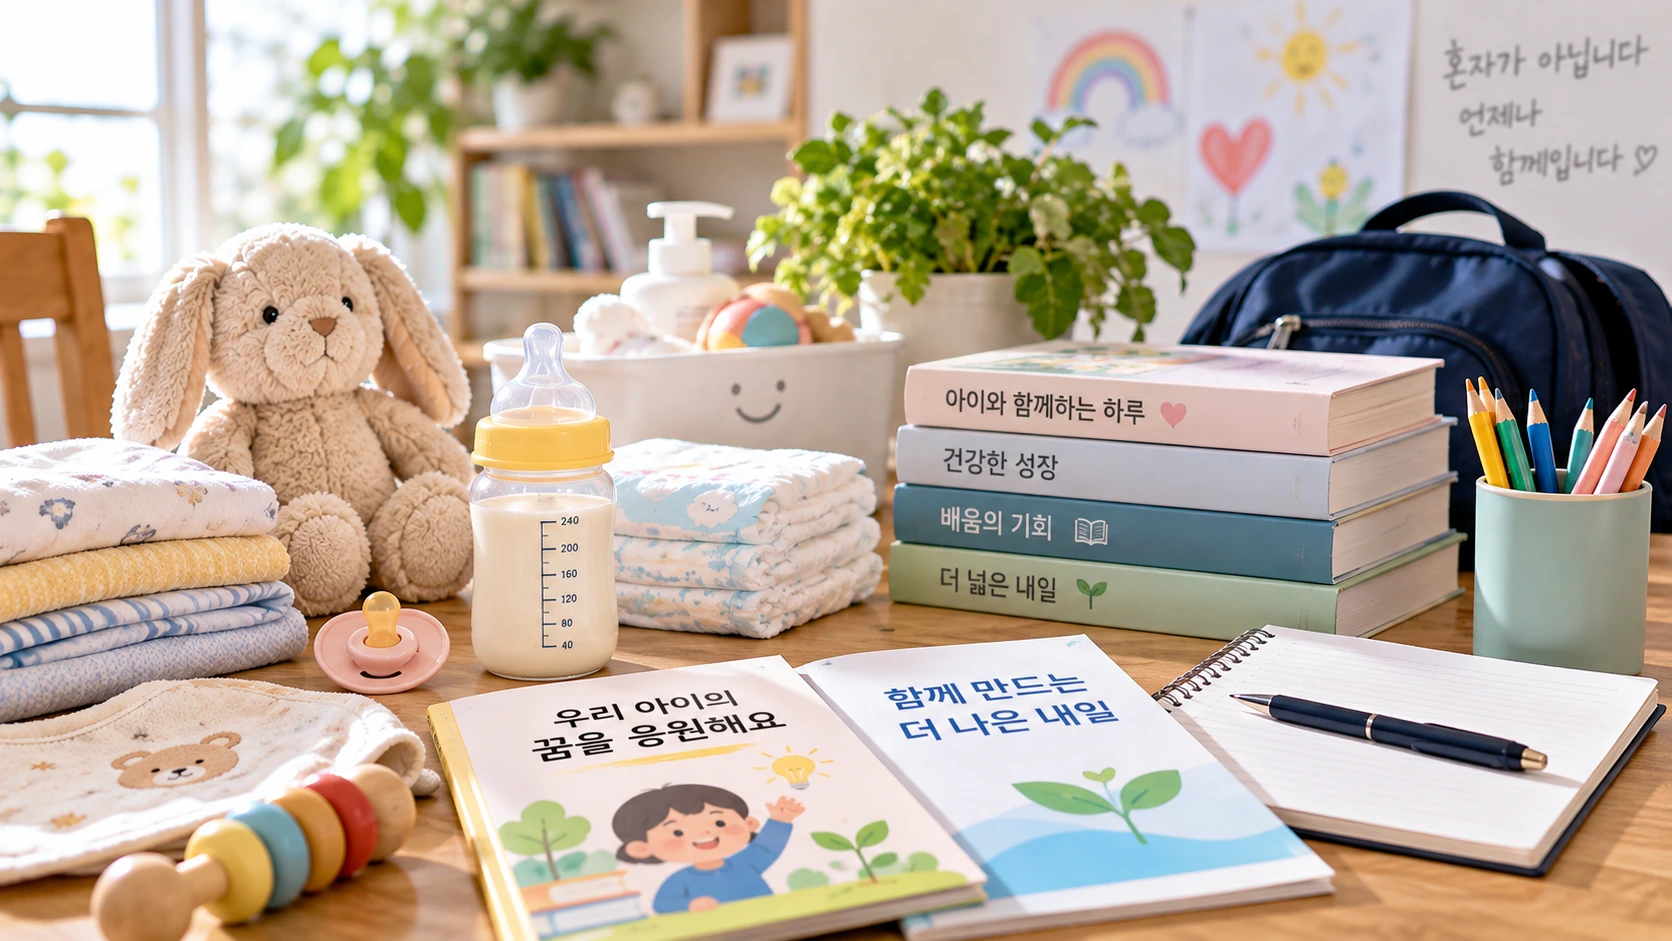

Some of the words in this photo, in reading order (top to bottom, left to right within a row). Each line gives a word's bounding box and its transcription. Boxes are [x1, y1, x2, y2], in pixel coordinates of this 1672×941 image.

[1442, 38, 1527, 91] 혼자가
[1538, 34, 1649, 80] 아닙니다
[1459, 98, 1543, 137] 언제나
[1489, 143, 1624, 186] 함께입니다
[945, 388, 1007, 416] 아이와
[1013, 391, 1096, 422] 함께하는
[1103, 398, 1145, 425] 하루
[943, 447, 1008, 477] 건강한
[1015, 452, 1059, 481] 성장
[560, 516, 579, 526] 240
[940, 506, 1002, 536] 배움의
[1011, 512, 1052, 541] 기회
[560, 543, 579, 553] 200
[561, 569, 578, 578] 160
[940, 567, 959, 593] 더
[968, 569, 1009, 598] 넓은
[1016, 575, 1056, 603] 내일
[561, 594, 577, 603] 120
[561, 619, 573, 627] 80
[561, 641, 573, 649] 40
[554, 703, 624, 728] 우리
[634, 690, 738, 715] 아이의
[884, 682, 967, 710] 함께
[970, 673, 1088, 701] 만드는
[532, 731, 613, 762] 꿈을
[628, 711, 787, 748] 응원해요
[899, 718, 942, 741] 더
[948, 709, 1030, 736] 나은
[1034, 700, 1119, 726] 내일
